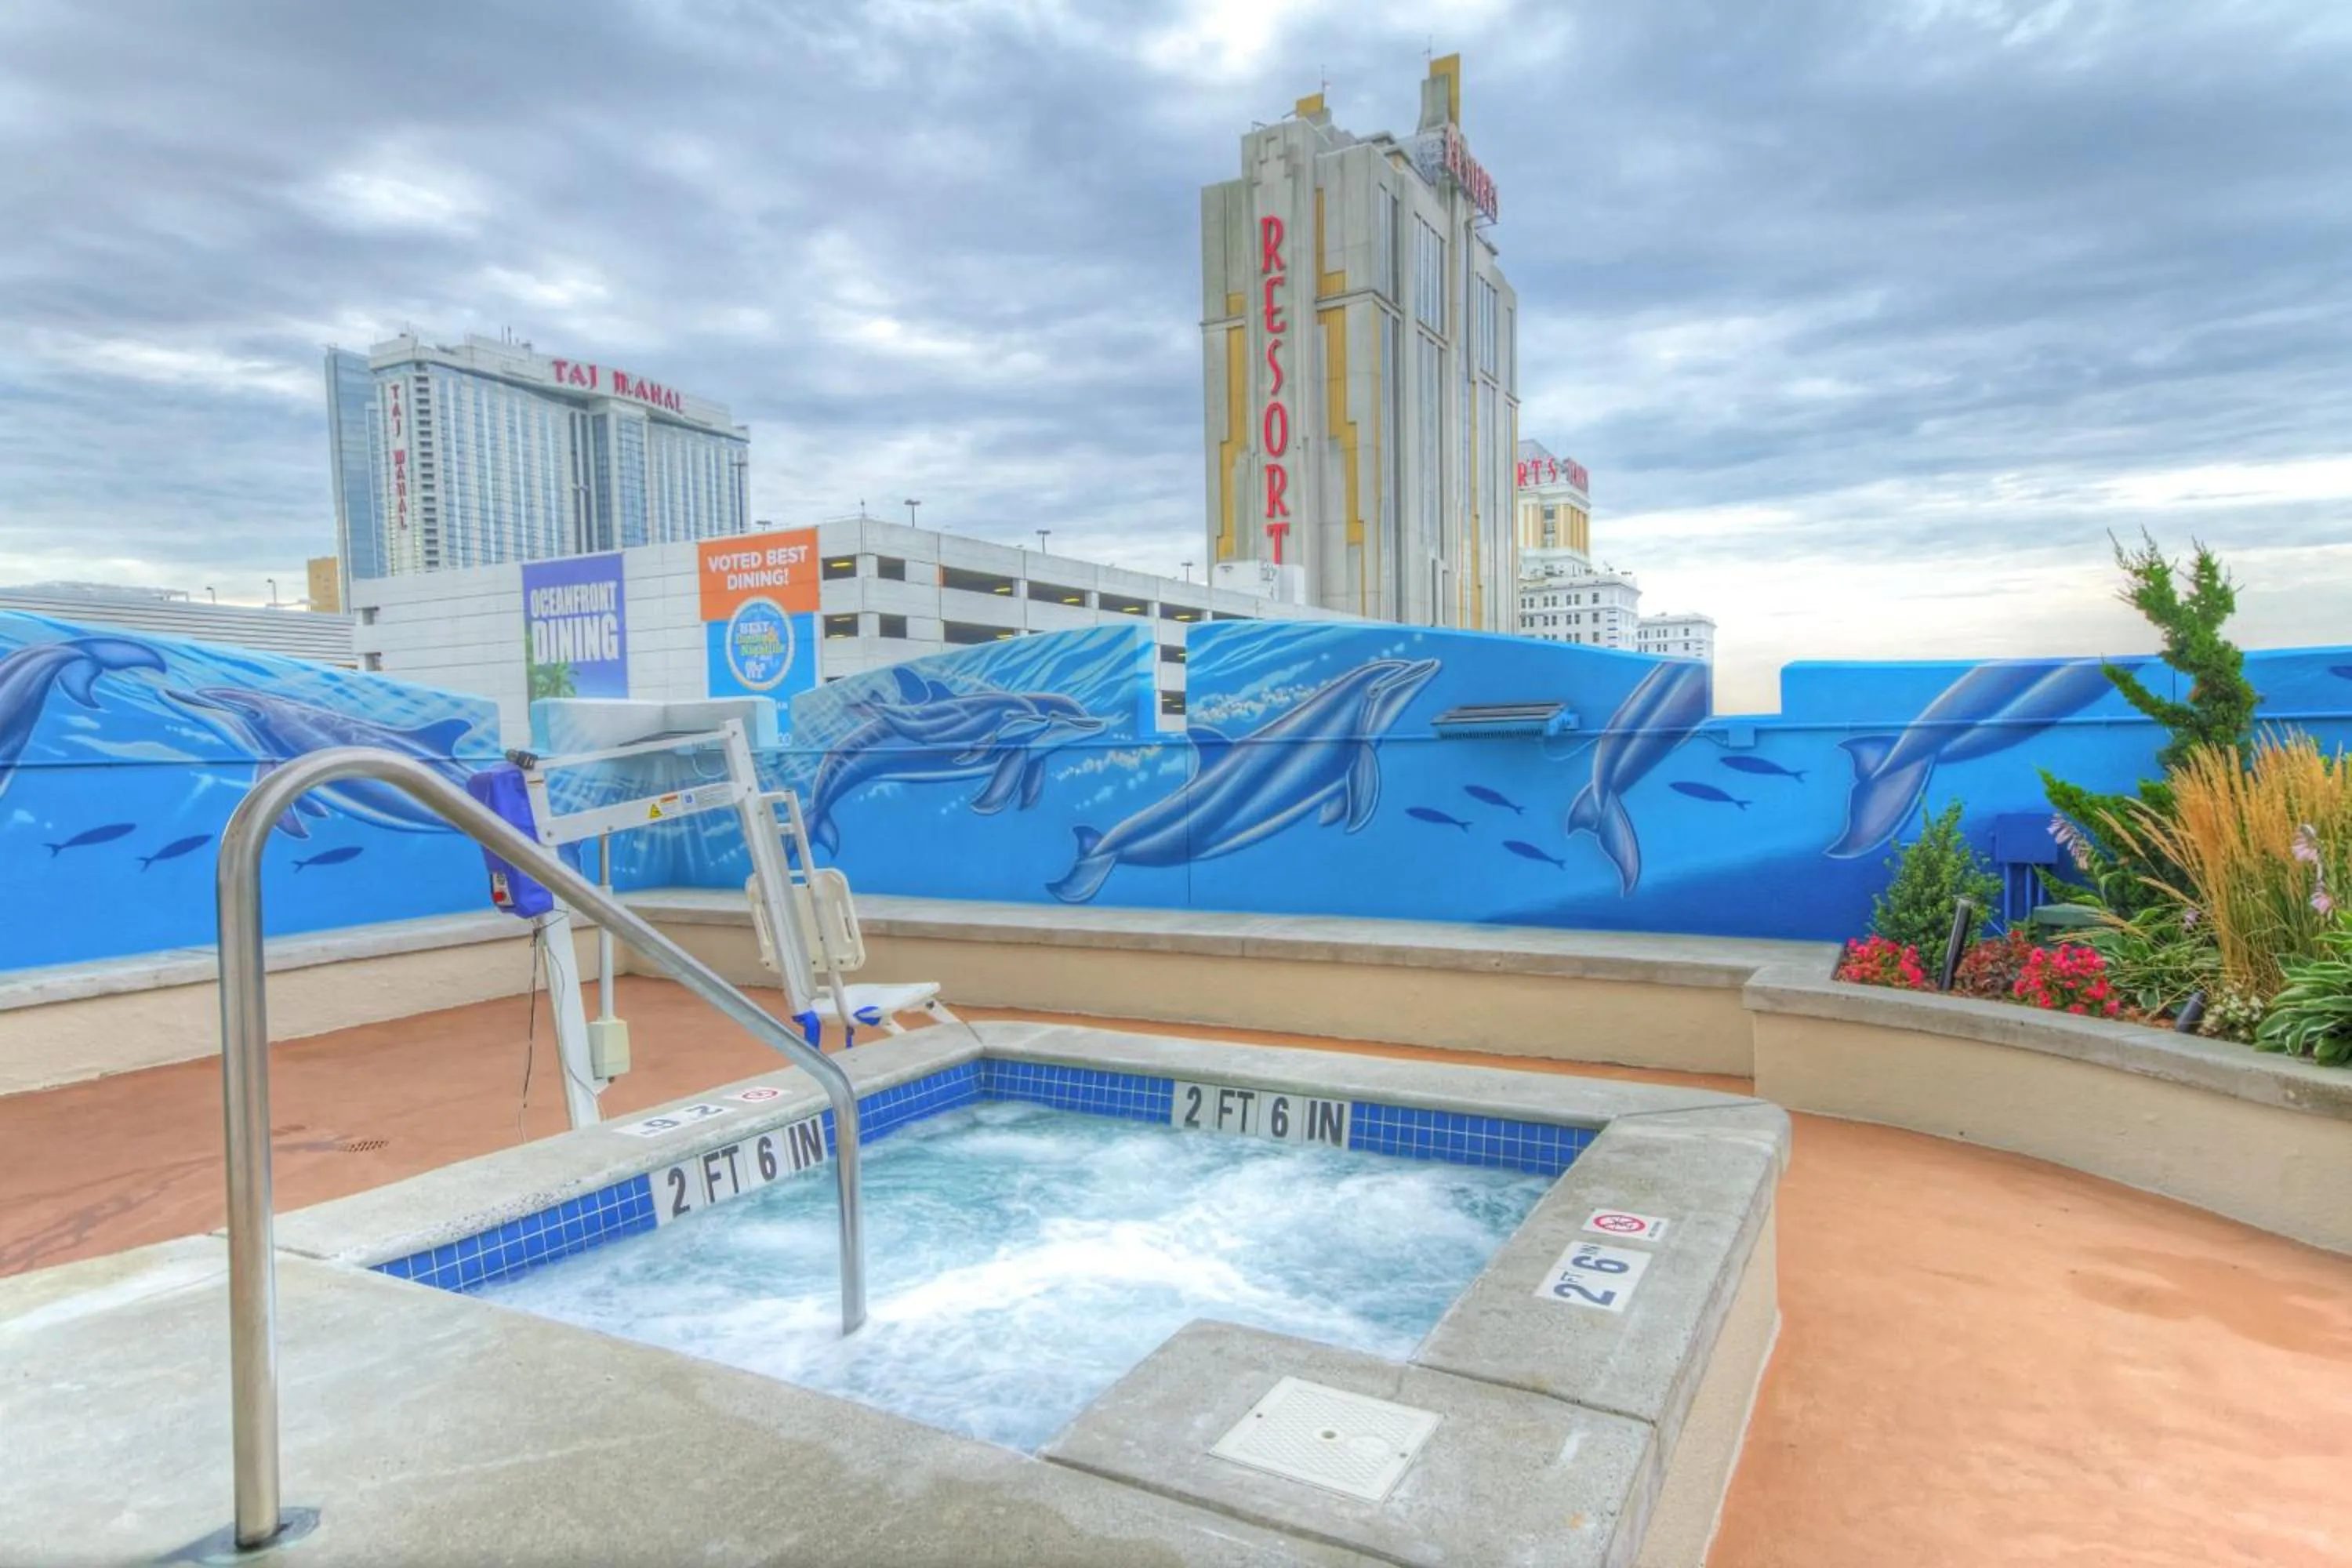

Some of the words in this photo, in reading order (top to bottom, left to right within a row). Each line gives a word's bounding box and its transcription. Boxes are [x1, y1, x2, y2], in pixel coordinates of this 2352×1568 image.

[391, 383, 401, 439] TAJ
[552, 359, 597, 390] TAJ
[613, 370, 684, 414] MAHAL
[1261, 215, 1290, 564] RESORT
[394, 449, 408, 530] MAHAL
[708, 551, 762, 573] VOTED
[766, 545, 809, 566] BEST
[727, 567, 789, 590] DINING!
[530, 580, 617, 618] OCEANFRONT
[532, 613, 619, 665] DINING
[1184, 1086, 1203, 1129] 2
[1218, 1089, 1254, 1134] FT
[1271, 1097, 1290, 1138] 6
[1308, 1100, 1345, 1147] IN
[667, 1167, 691, 1216] 2
[702, 1145, 739, 1203] FT
[757, 1136, 777, 1181] 6
[788, 1118, 823, 1171] IN
[1571, 1255, 1630, 1274] 6
[1553, 1283, 1617, 1306] 2
